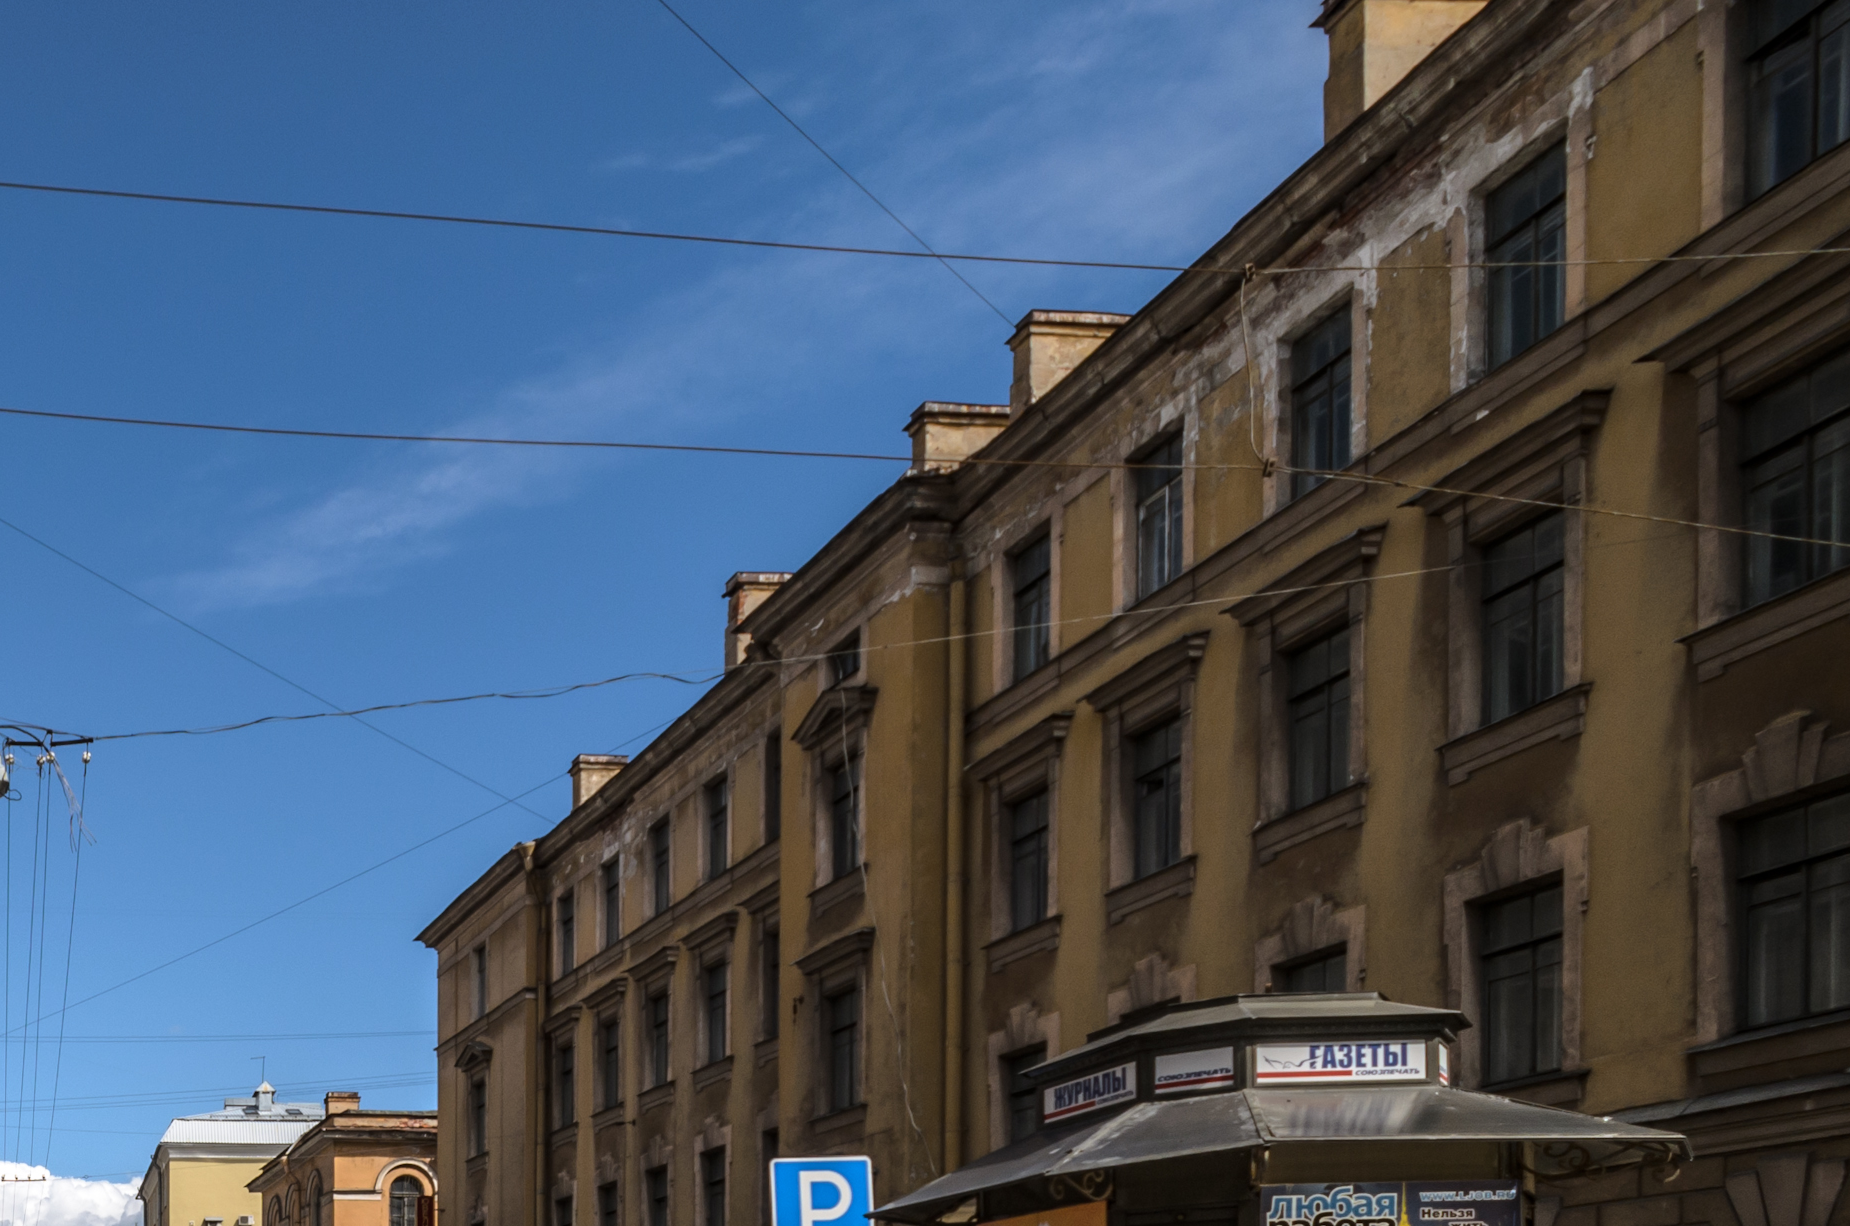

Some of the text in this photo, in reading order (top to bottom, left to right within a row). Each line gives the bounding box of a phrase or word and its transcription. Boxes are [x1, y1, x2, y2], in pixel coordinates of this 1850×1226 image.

[1308, 1043, 1409, 1070] ГАЗЕТЫ
[1156, 1067, 1232, 1083] СОЮЗПЕЧАТЬ
[1355, 1067, 1420, 1077] СОЮЗПЕЧАТЬ
[1053, 1067, 1127, 1110] ЖУРНАЛЫ
[1268, 1185, 1399, 1220] любая
[1419, 1207, 1476, 1220] Нельзя
